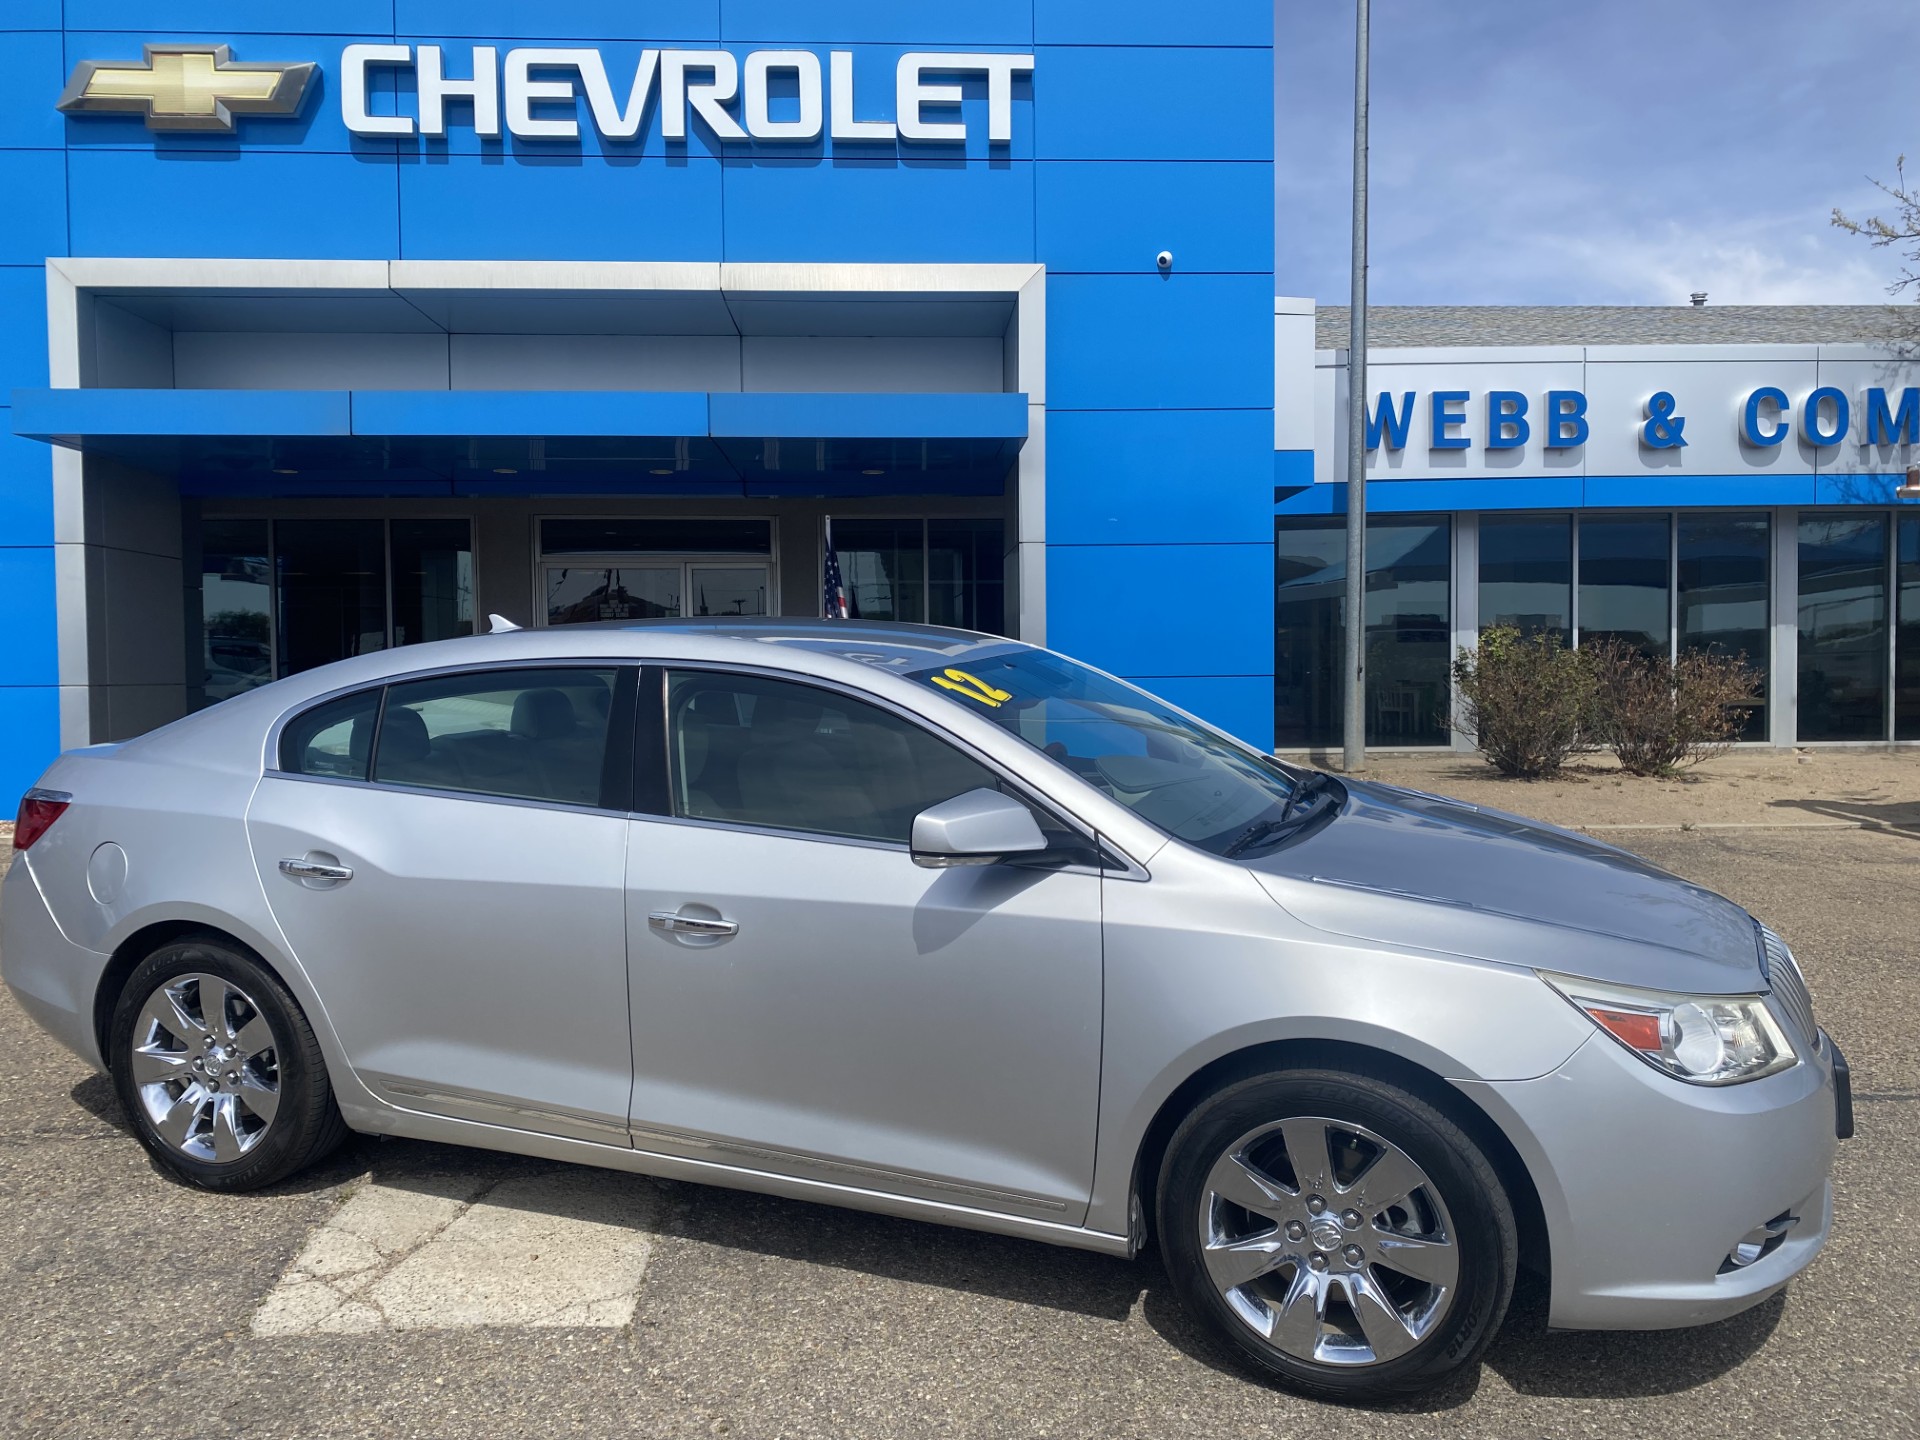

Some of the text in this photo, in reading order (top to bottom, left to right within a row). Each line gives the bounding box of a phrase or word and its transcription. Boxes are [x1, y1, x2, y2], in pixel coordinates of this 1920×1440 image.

[341, 43, 1035, 146] CHEVROLET
[1365, 386, 1920, 450] WEBB & COM
[930, 668, 1013, 708] 12
